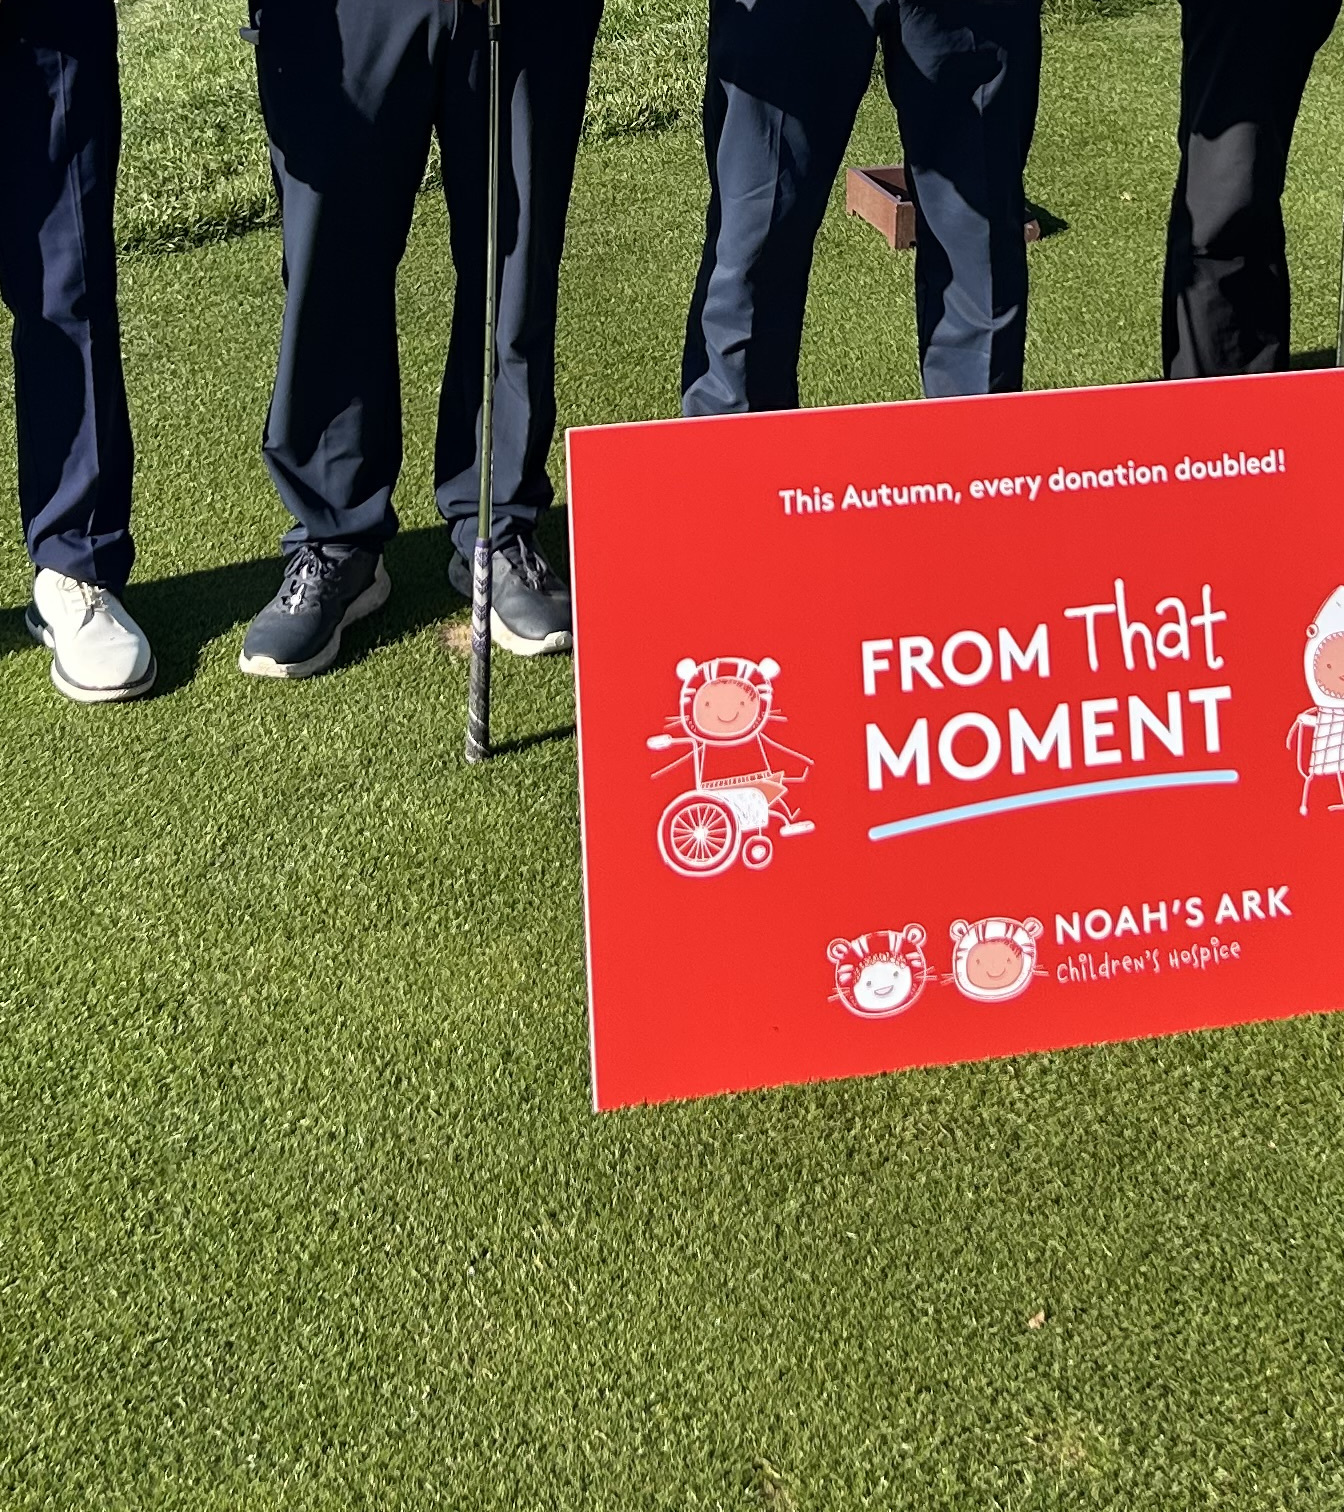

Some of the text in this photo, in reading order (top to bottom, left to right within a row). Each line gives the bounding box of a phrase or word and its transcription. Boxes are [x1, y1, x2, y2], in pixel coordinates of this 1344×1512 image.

[778, 447, 1287, 515] This Autumn, every donation doubled!
[860, 578, 1228, 697] FROM That
[865, 685, 1233, 791] MOMENT
[1054, 884, 1293, 946] NOAH'S ARK
